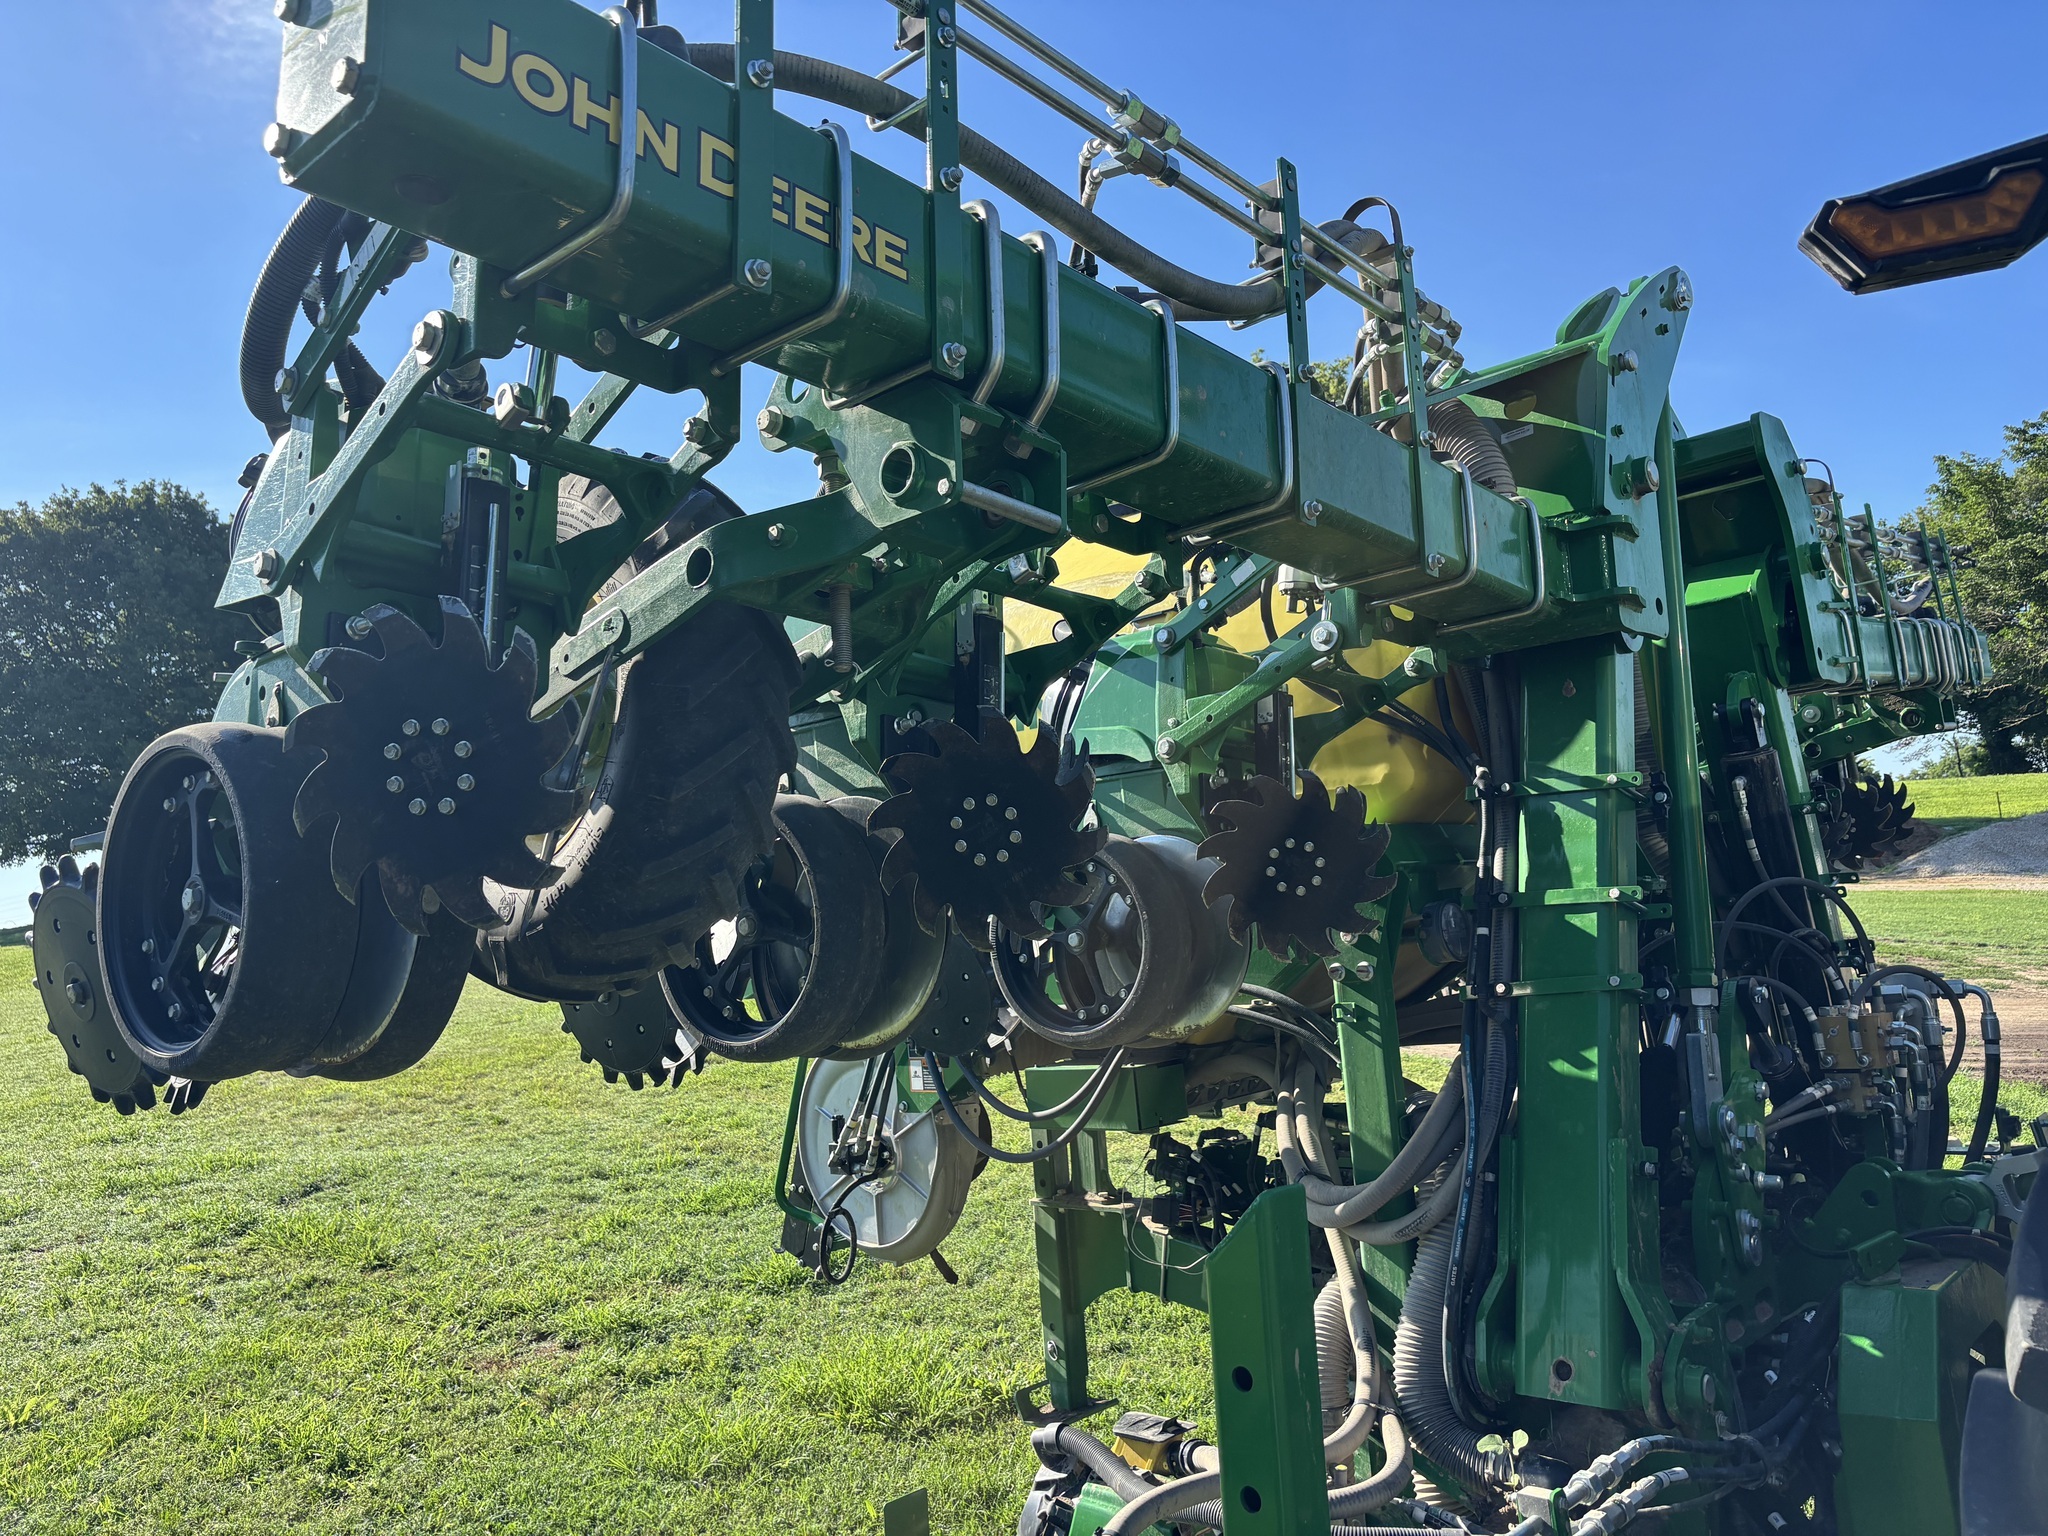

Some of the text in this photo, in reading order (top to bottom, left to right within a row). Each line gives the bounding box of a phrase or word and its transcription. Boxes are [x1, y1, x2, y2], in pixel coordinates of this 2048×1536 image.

[457, 20, 680, 176] JOHN
[989, 694, 996, 704] 2
[1450, 1266, 1458, 1286] GATES
